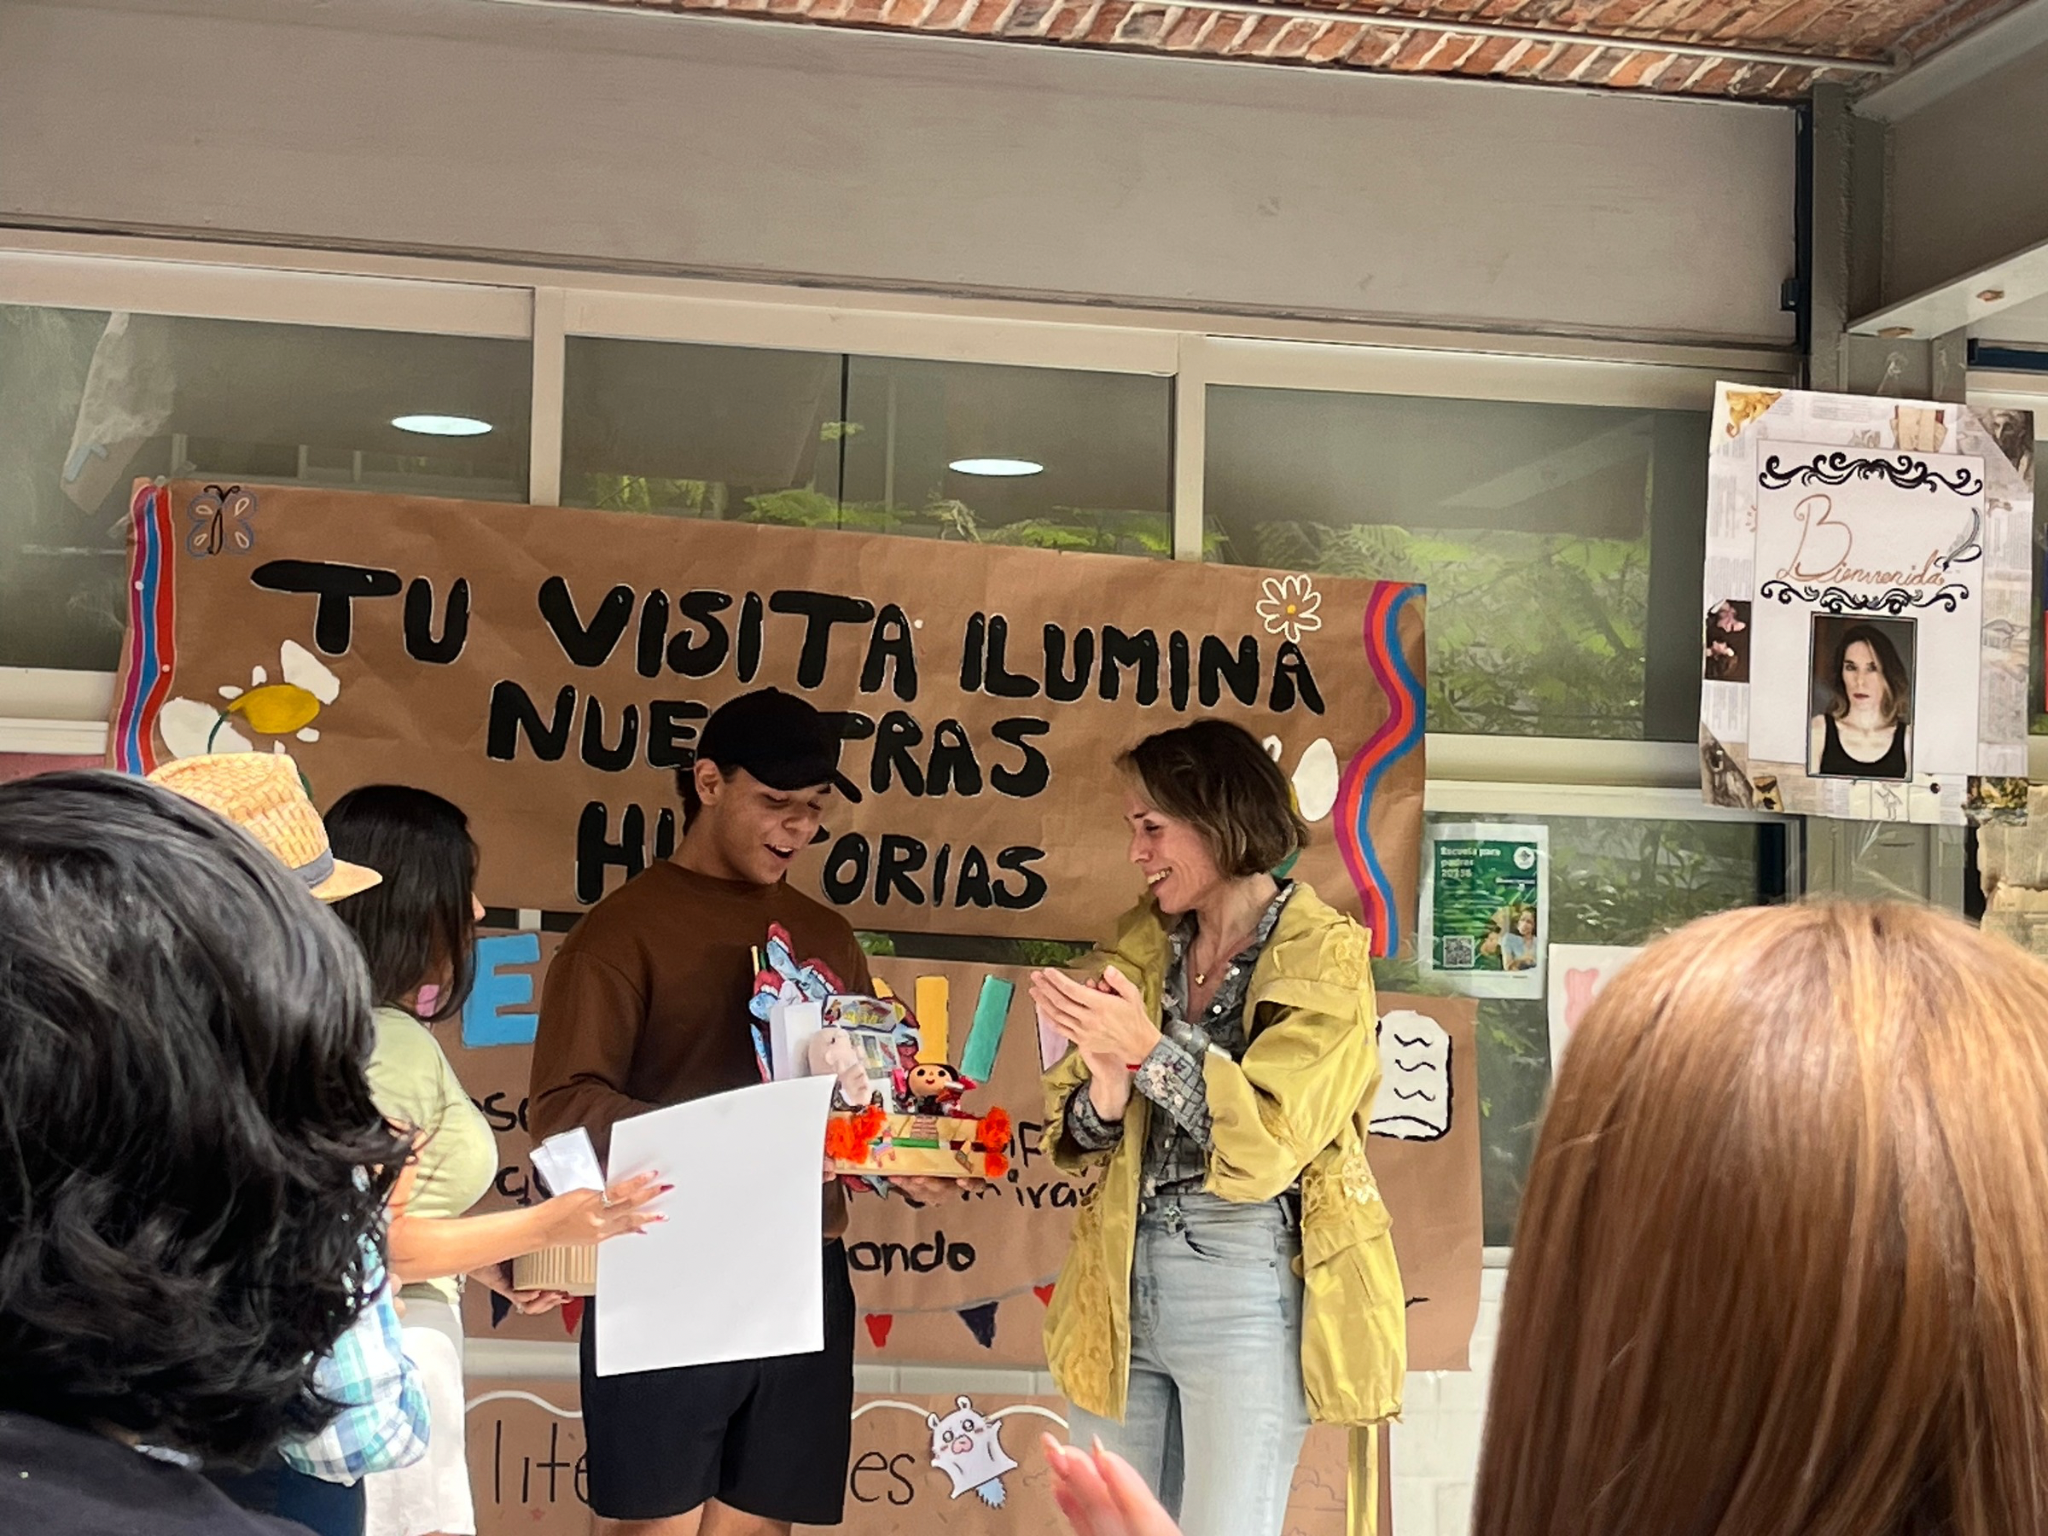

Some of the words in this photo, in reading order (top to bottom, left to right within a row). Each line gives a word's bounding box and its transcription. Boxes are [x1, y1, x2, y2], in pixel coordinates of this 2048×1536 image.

[1776, 493, 1945, 587] Bienvenida
[250, 559, 470, 664] TU
[538, 575, 918, 701] VISITA
[960, 611, 1325, 715] ILUMINA
[487, 680, 1050, 798] NUETRAS
[575, 800, 1048, 910] HIORIAS
